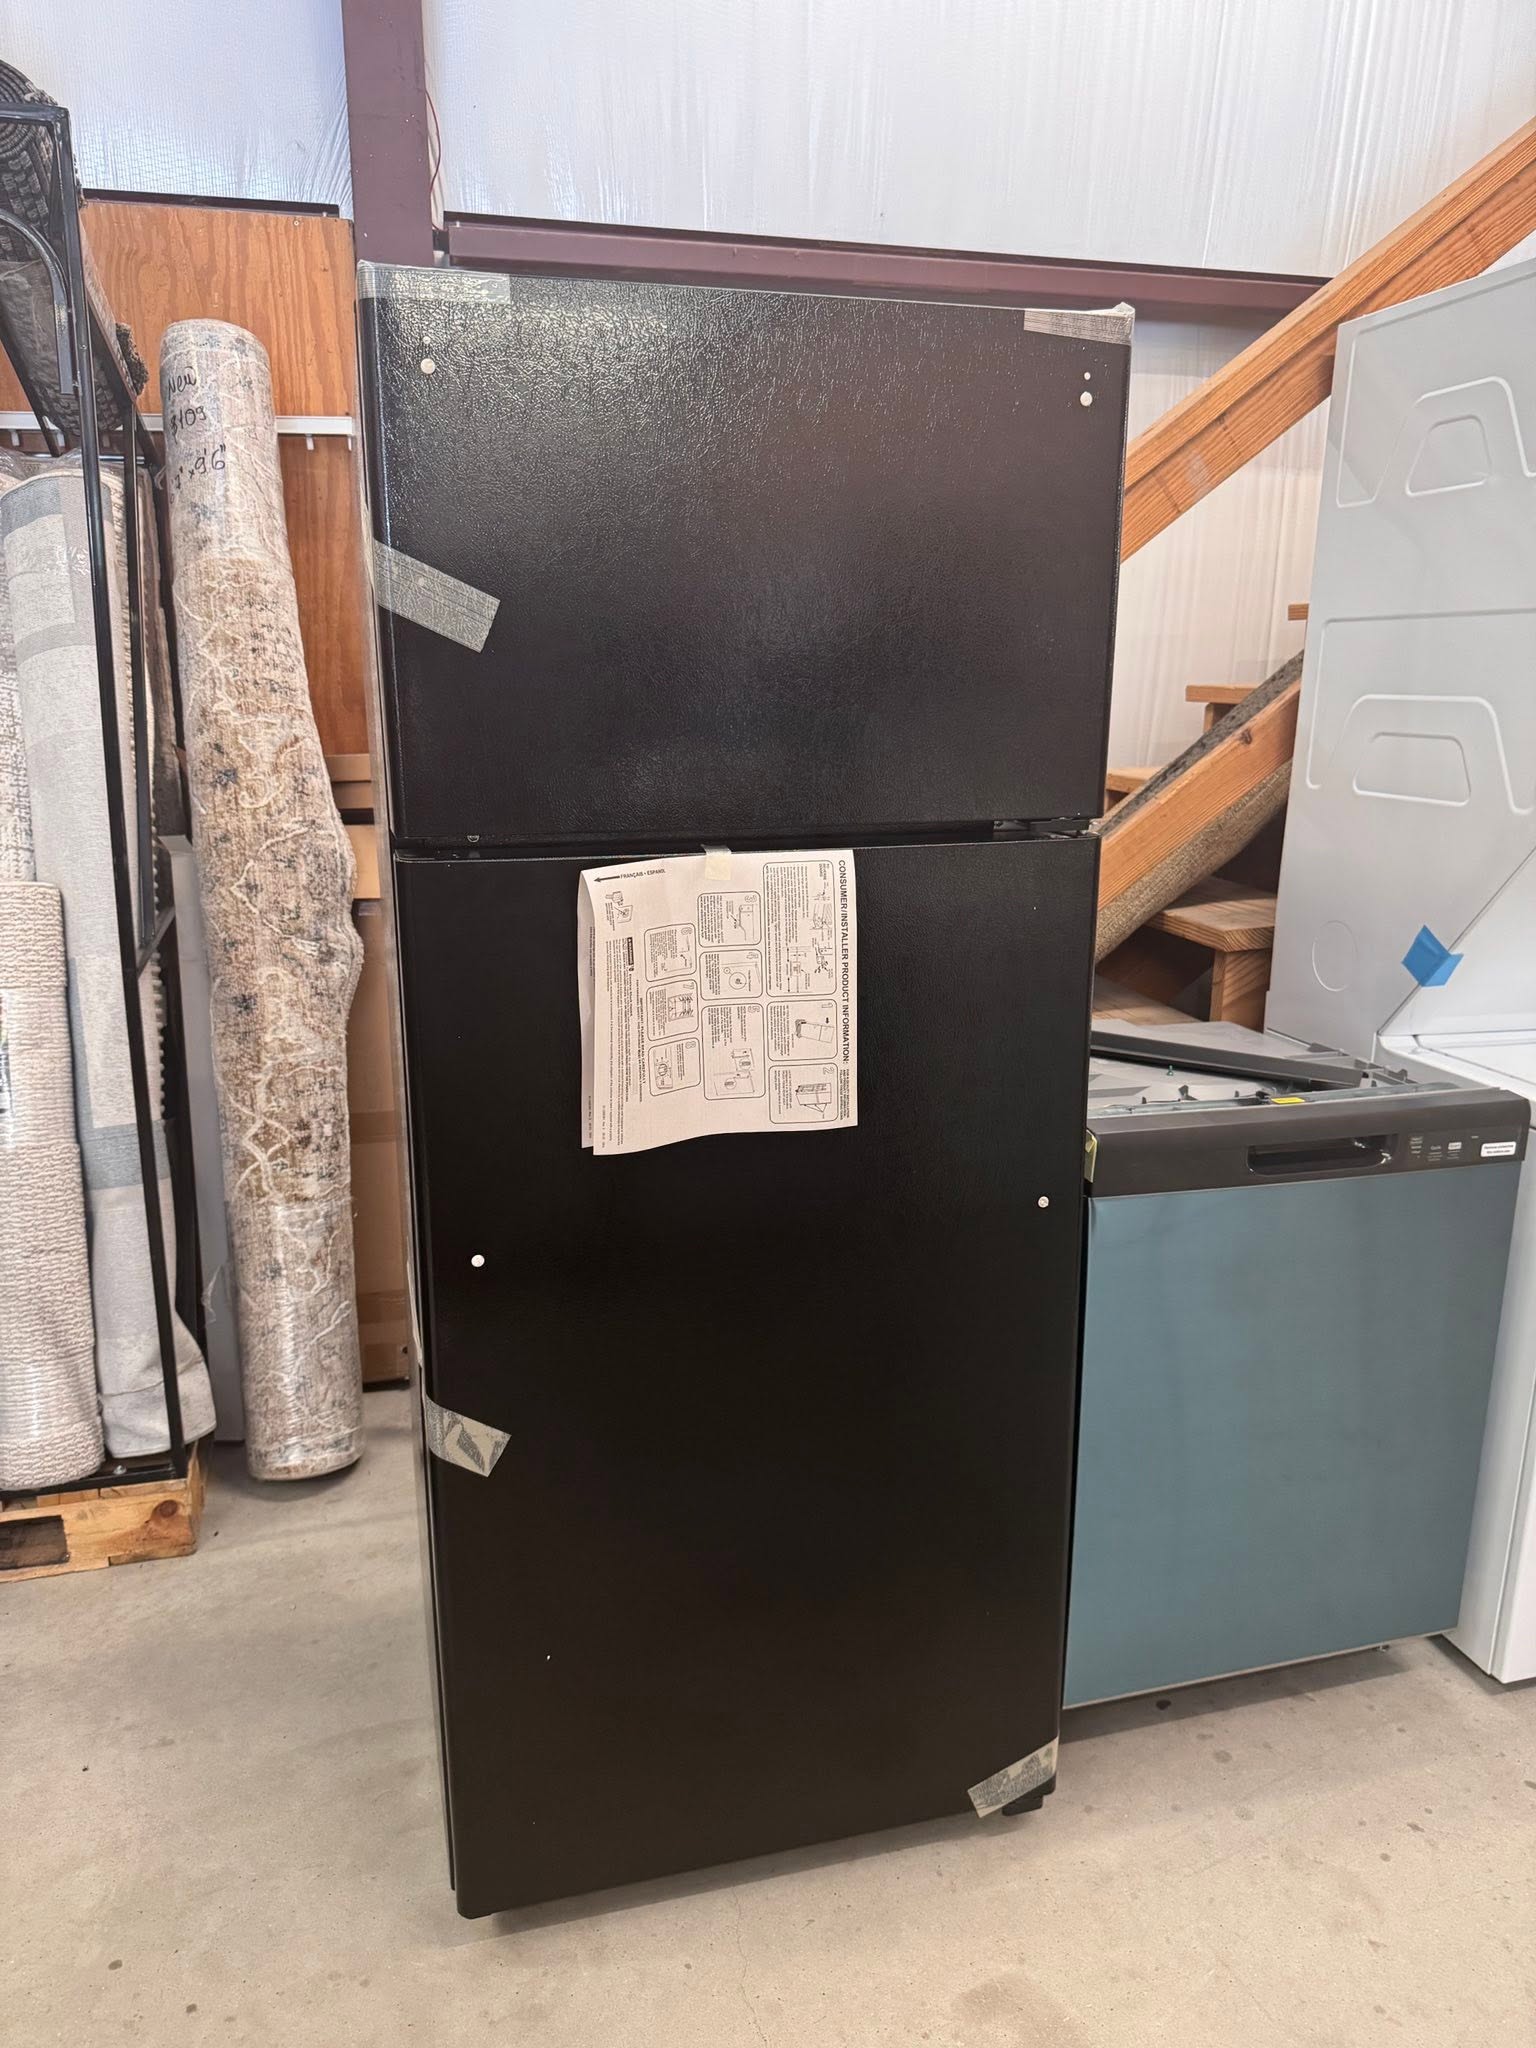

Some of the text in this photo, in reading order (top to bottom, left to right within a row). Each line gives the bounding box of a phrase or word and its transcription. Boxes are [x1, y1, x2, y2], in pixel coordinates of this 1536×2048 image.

[168, 366, 197, 400] New
[745, 895, 757, 904] 3
[838, 860, 849, 960] CONSUMER/INSTALLER
[683, 982, 694, 990] 7
[842, 1005, 850, 1064] INFORMATION:
[823, 1067, 835, 1075] 2
